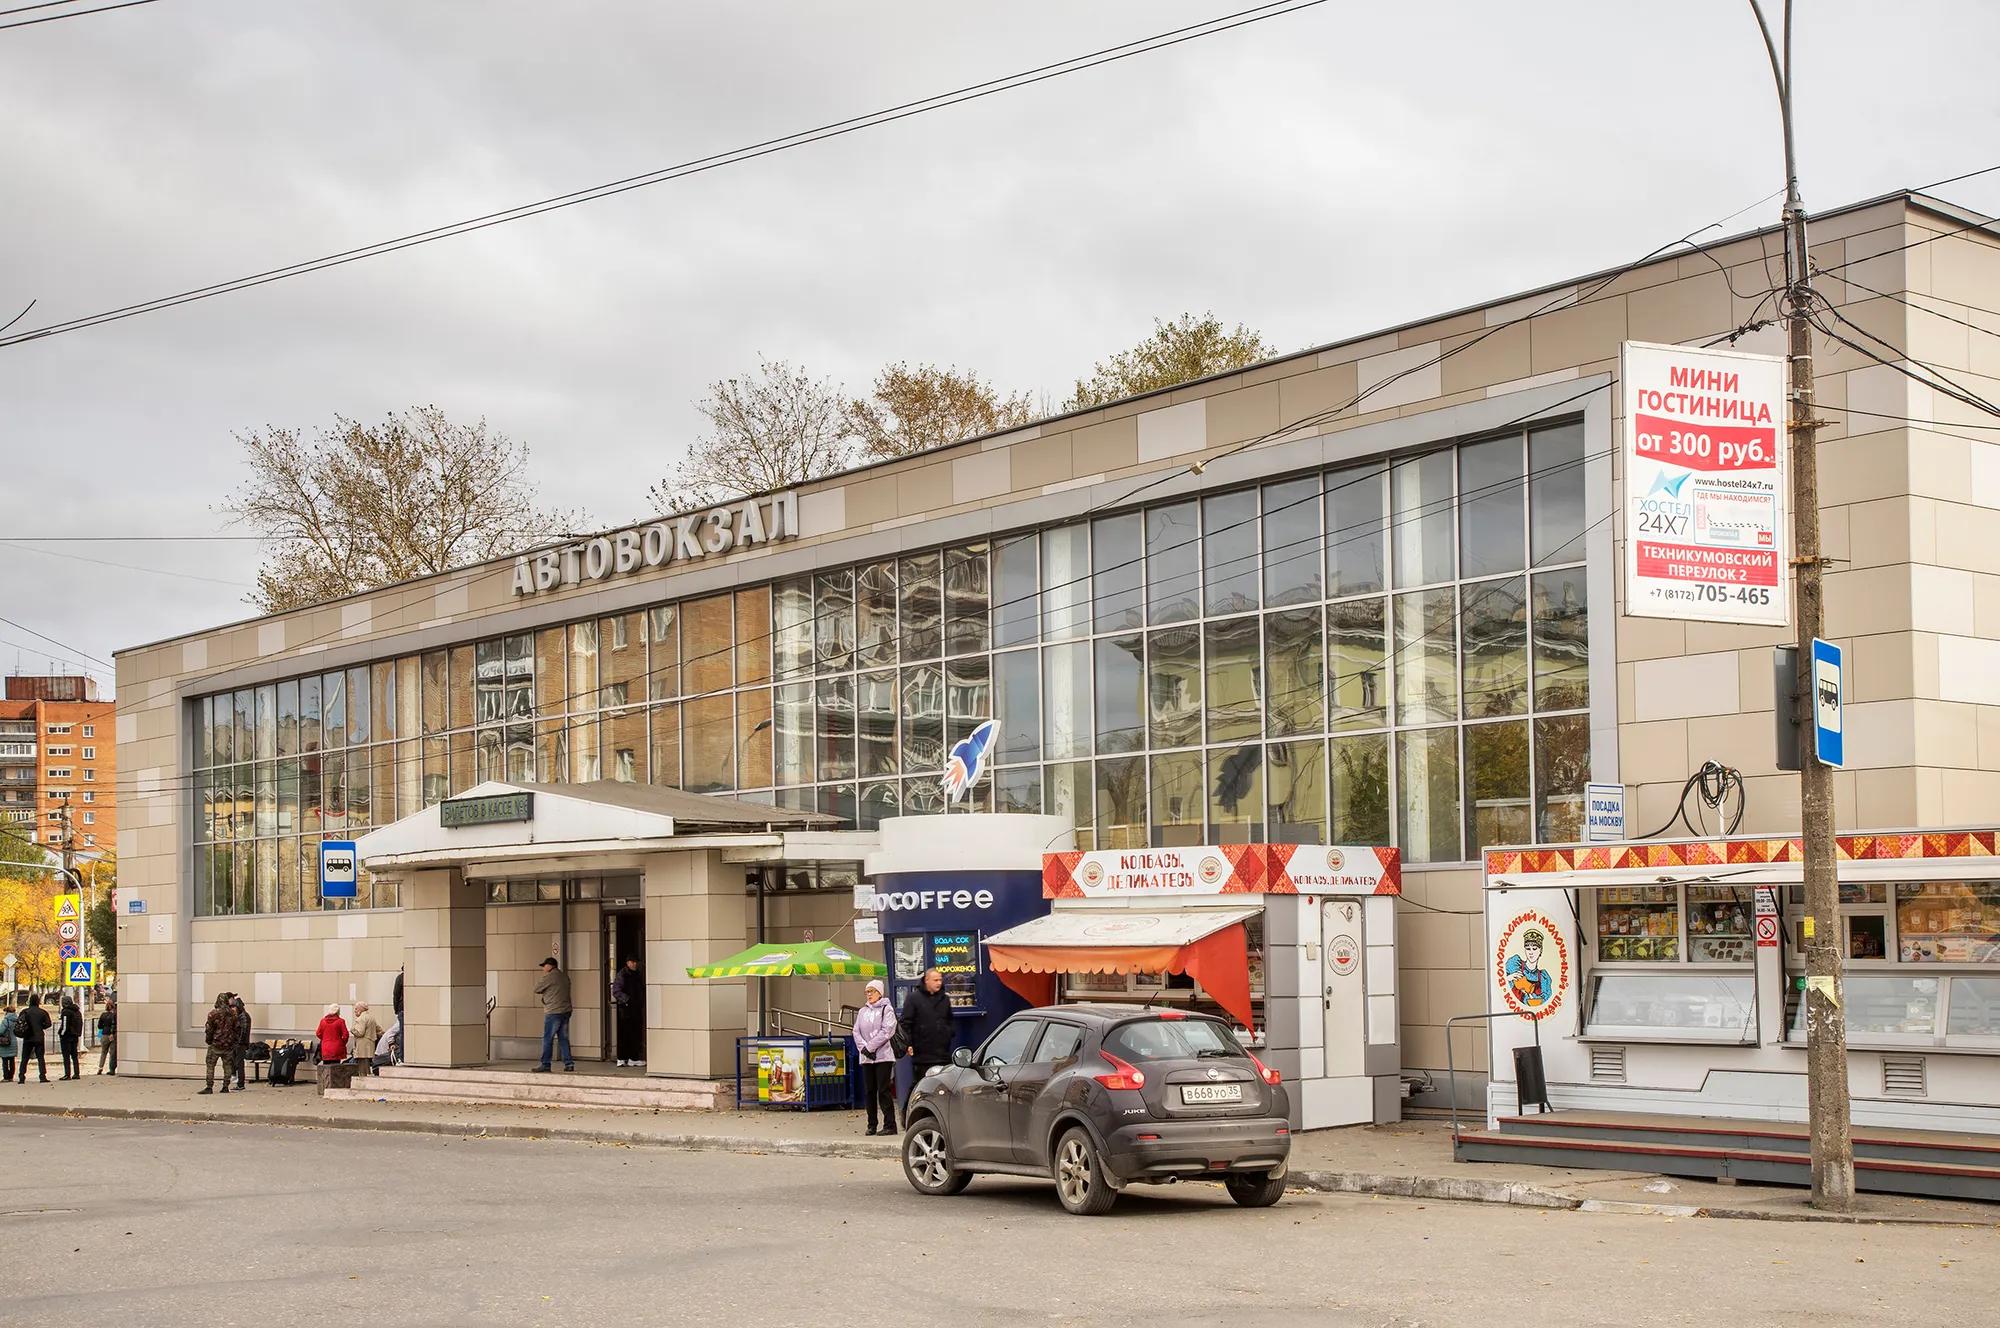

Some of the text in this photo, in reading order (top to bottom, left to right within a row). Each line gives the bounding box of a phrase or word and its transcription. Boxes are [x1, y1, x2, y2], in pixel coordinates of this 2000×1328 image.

[1670, 366, 1739, 393] МИНИ
[1638, 389, 1772, 426] ГОСТИНИЦА
[1638, 432, 1663, 451] от
[1669, 430, 1711, 457] 300
[1694, 478, 1774, 490] www.hostel24x7.ru
[1697, 492, 1708, 500] ГДЕ
[1723, 494, 1771, 503] НАХОДИМСЯ?
[1640, 499, 1691, 516] ХОСТЕЛ
[511, 490, 799, 596] АВТОВОКЗАЛ
[1643, 545, 1772, 567] ТЕХНИКУМОВСКИЙ
[1668, 564, 1747, 581] ПЕРЕУЛОК 2
[1650, 584, 1769, 605] +7 (8172) 705-465
[1592, 800, 1620, 813] ПОСАДКА
[1590, 816, 1623, 827] НА МОСКВУ
[1107, 872, 1195, 890] ДЕЛИКАТЕСЫ
[62, 926, 74, 934] 40
[1497, 909, 1537, 987] ВОЛОГОДСКИЙ
[1539, 916, 1569, 990] МОЛОЧНЫЙ
[1123, 1108, 1146, 1116] JUKE
